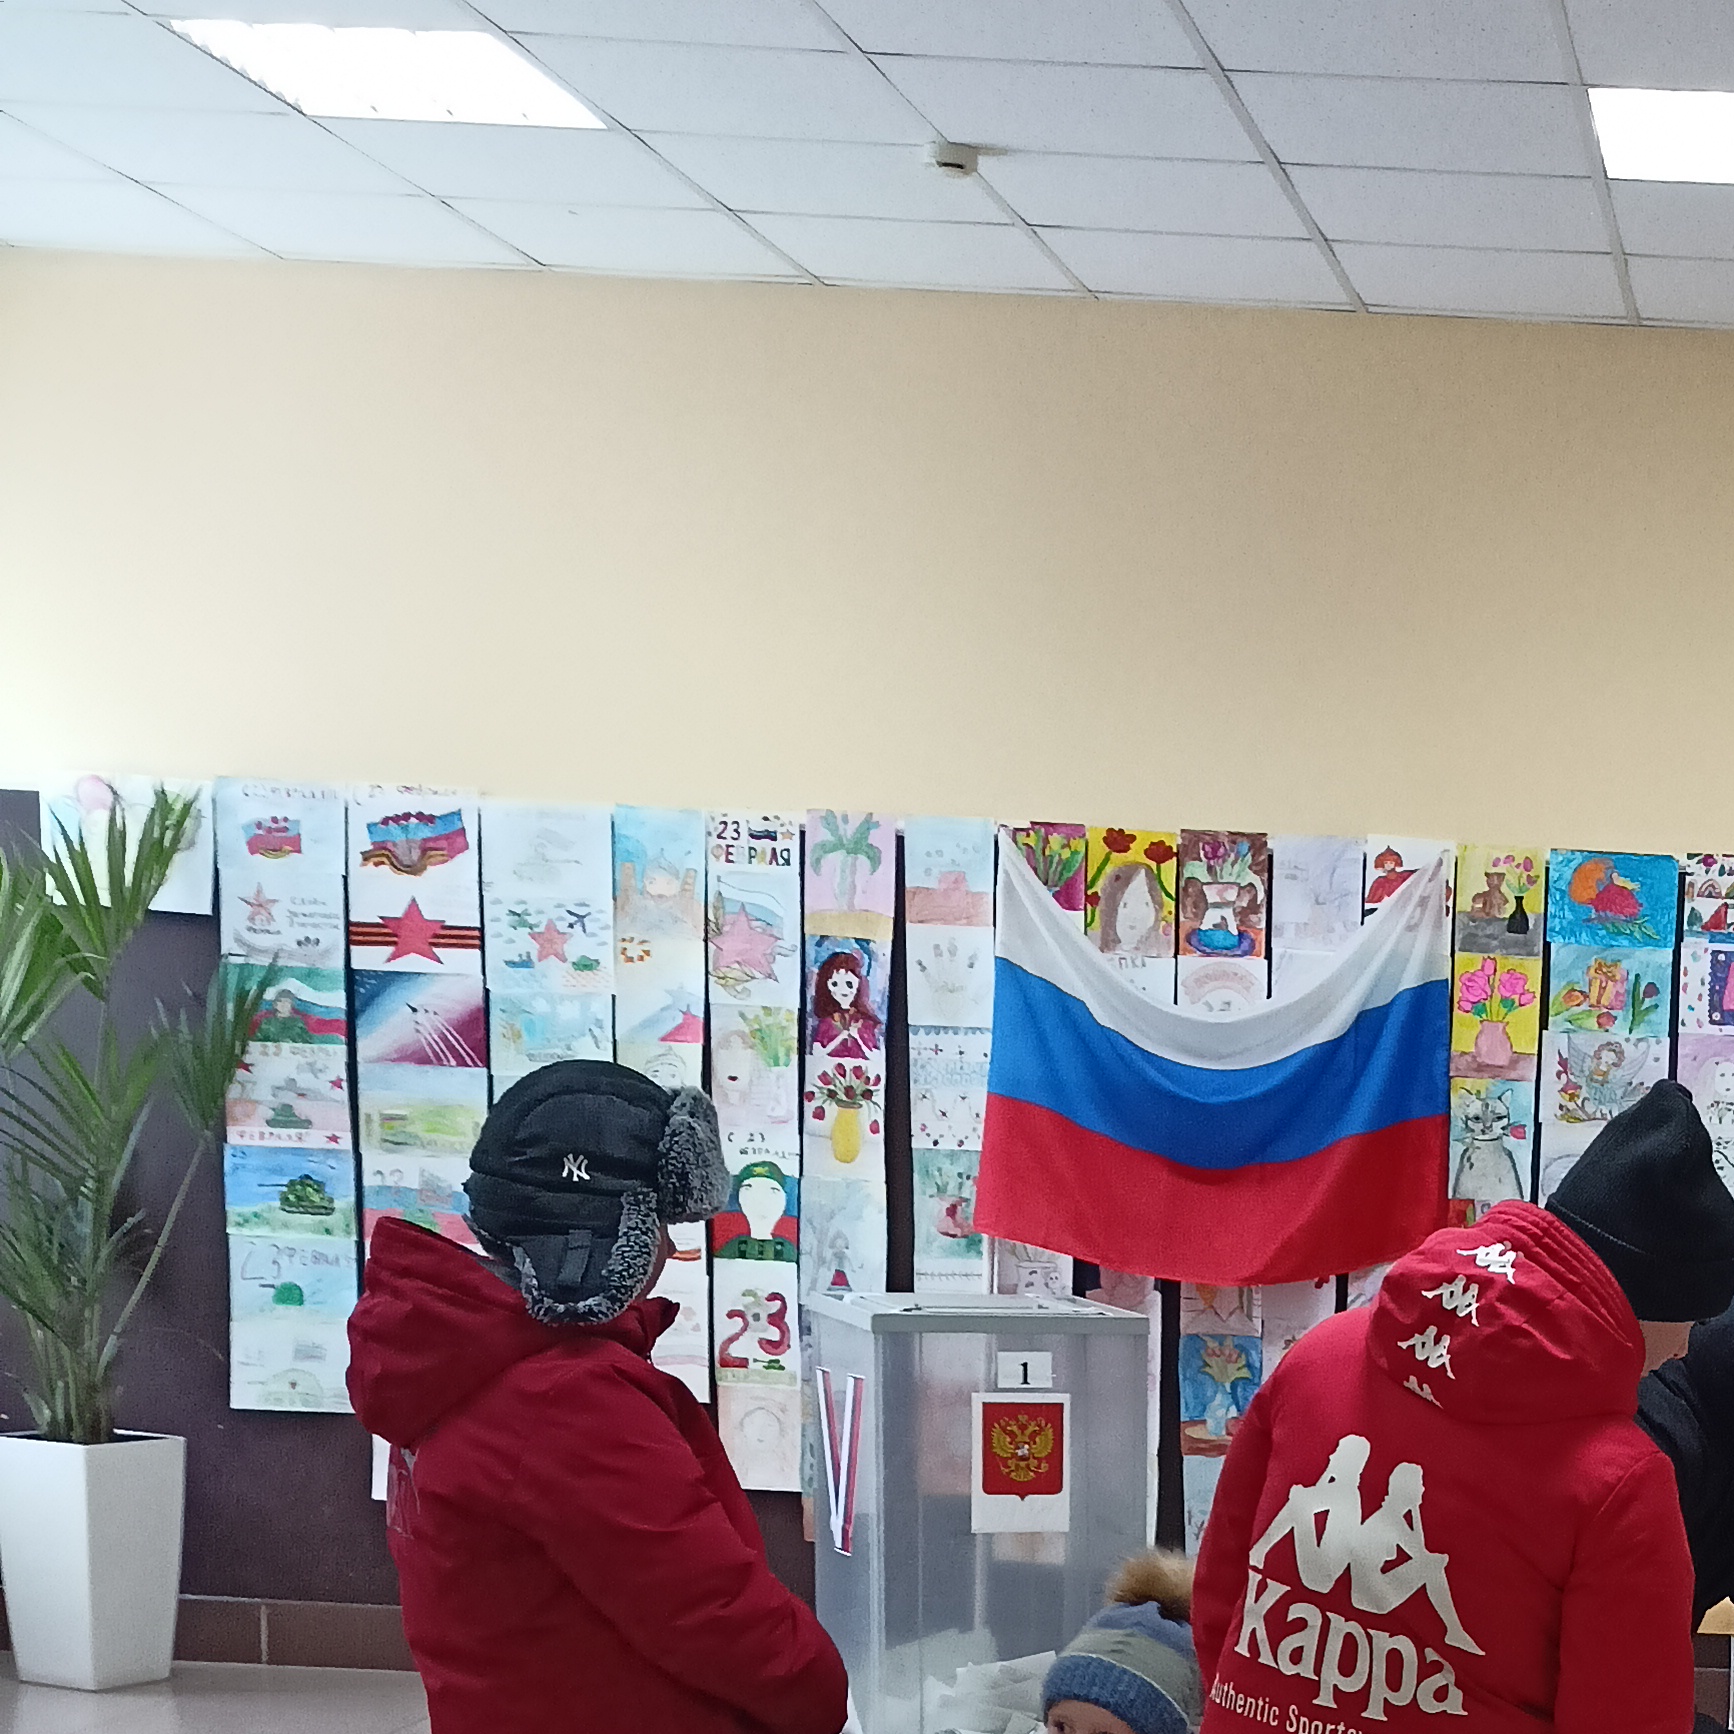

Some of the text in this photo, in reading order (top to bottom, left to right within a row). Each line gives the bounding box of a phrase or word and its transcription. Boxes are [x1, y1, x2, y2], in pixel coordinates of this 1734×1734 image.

[716, 820, 741, 840] 23
[562, 1153, 591, 1182] NY
[1019, 1361, 1031, 1386] 1
[1234, 1568, 1469, 1721] Kappa
[1208, 1672, 1279, 1727] Authentic
